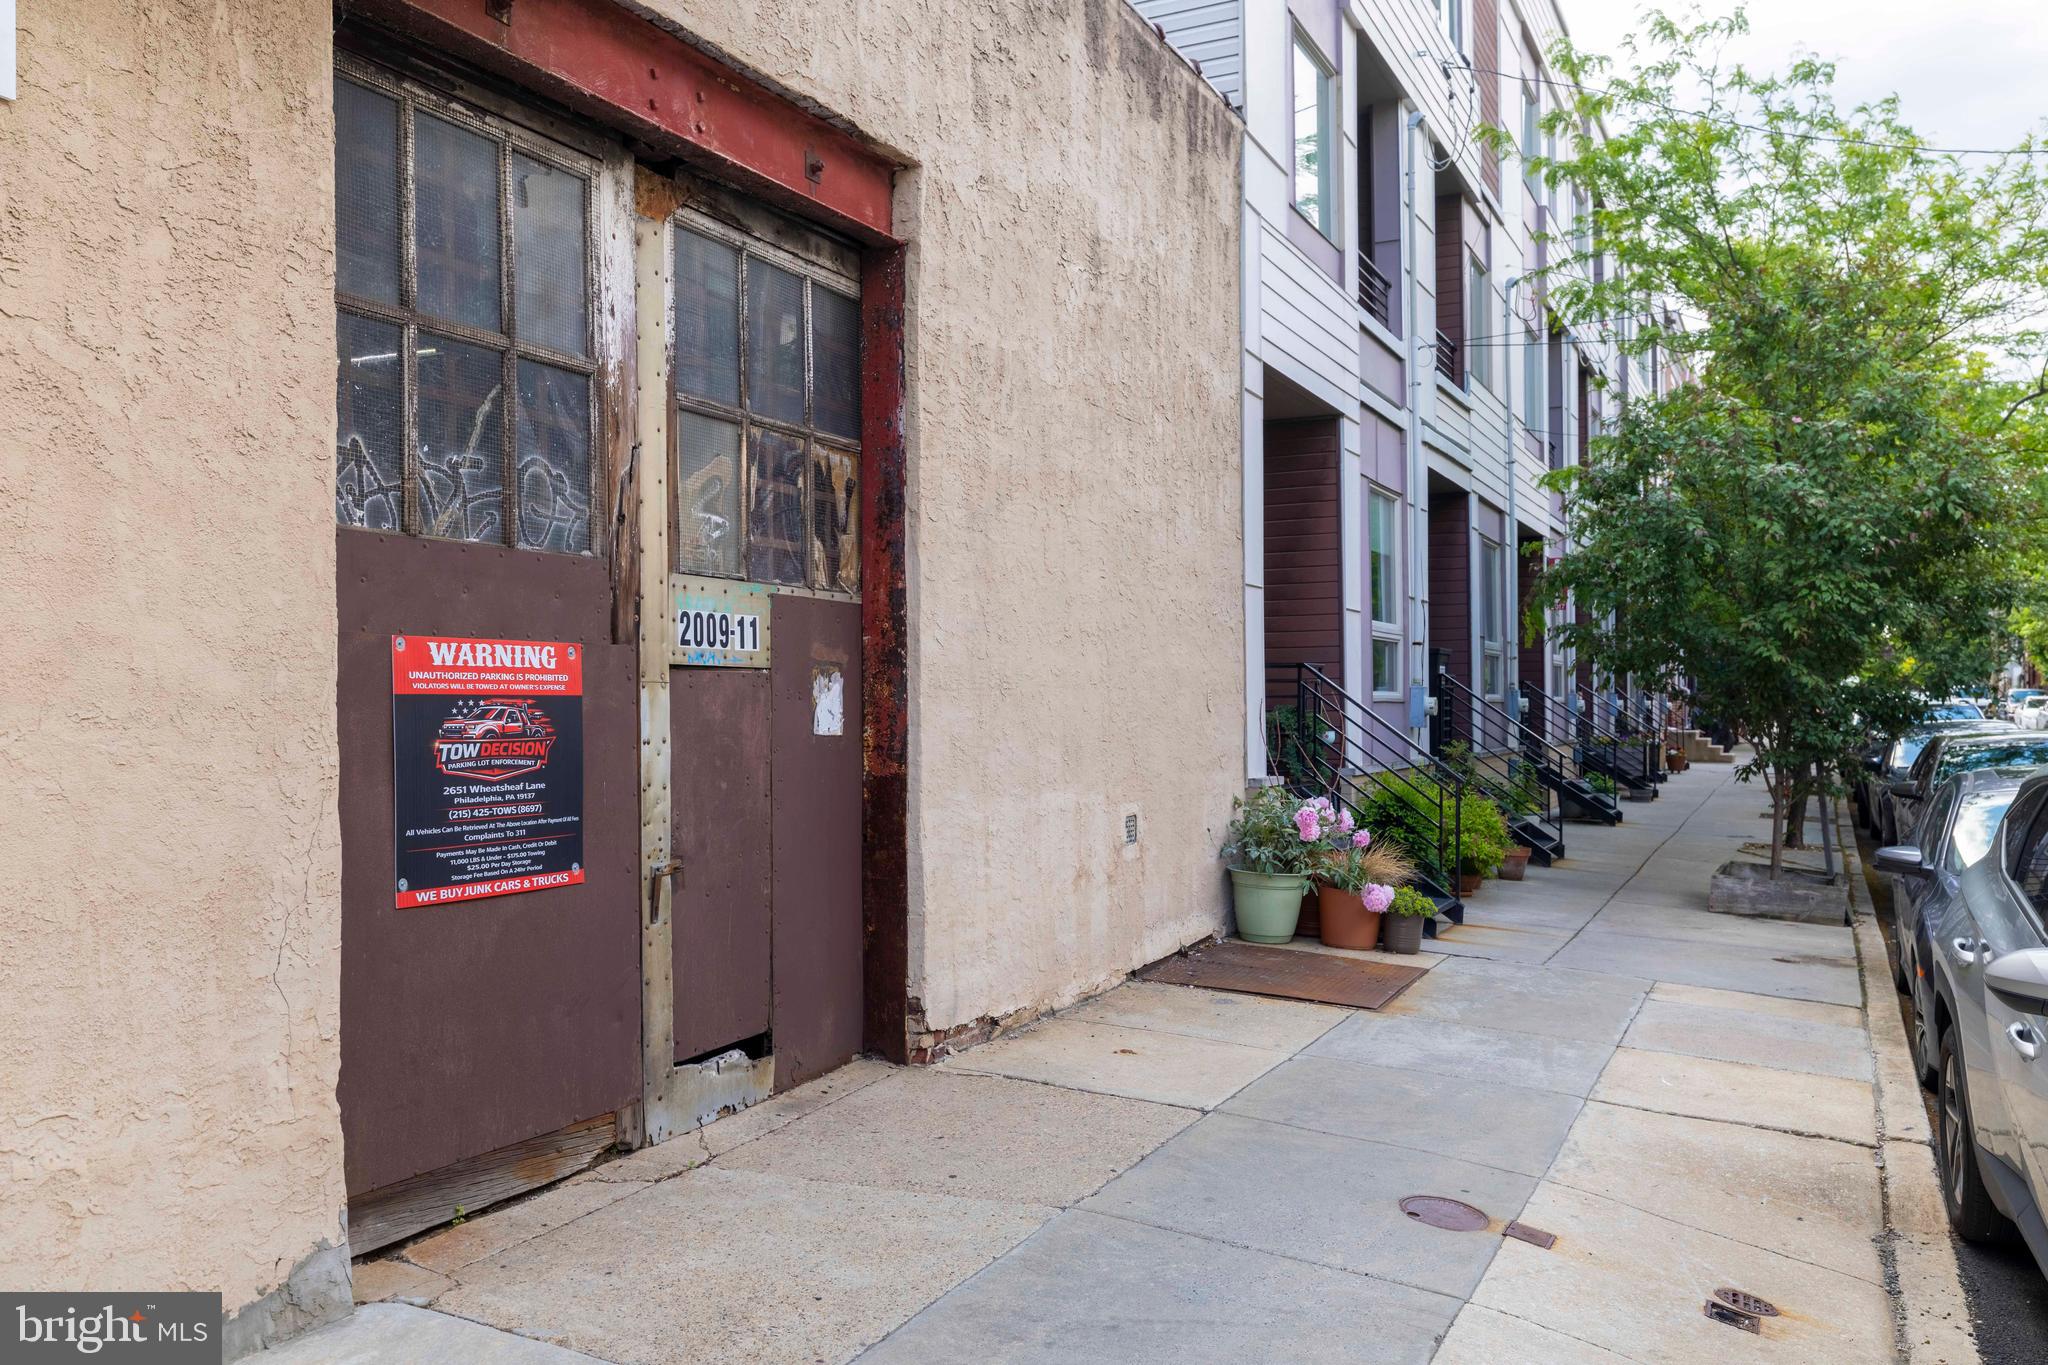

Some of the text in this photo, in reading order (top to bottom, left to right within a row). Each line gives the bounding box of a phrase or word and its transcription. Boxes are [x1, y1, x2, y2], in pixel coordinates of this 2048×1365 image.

[679, 610, 758, 650] 2009-11
[427, 642, 557, 669] WARNING
[409, 671, 478, 680] UNAUTHORIZED
[480, 673, 515, 681] PARKING
[525, 674, 569, 682] PROHIBITED
[448, 761, 476, 770] PARKING
[443, 782, 546, 795] 2651 Wheatsheaf Lane
[454, 795, 504, 804] Philadelphia,
[448, 804, 542, 820] (215) 425-TOWS (8697)
[416, 827, 441, 835] Vehicles
[463, 823, 488, 831] Retrieved
[464, 832, 504, 841] Complaints
[436, 850, 464, 858] Payments
[465, 848, 477, 856] May
[486, 845, 501, 853] Made
[486, 854, 502, 862] Under
[467, 863, 490, 871] $25.00
[415, 873, 569, 902] WE BUY JUNK CARS & TRUCKS
